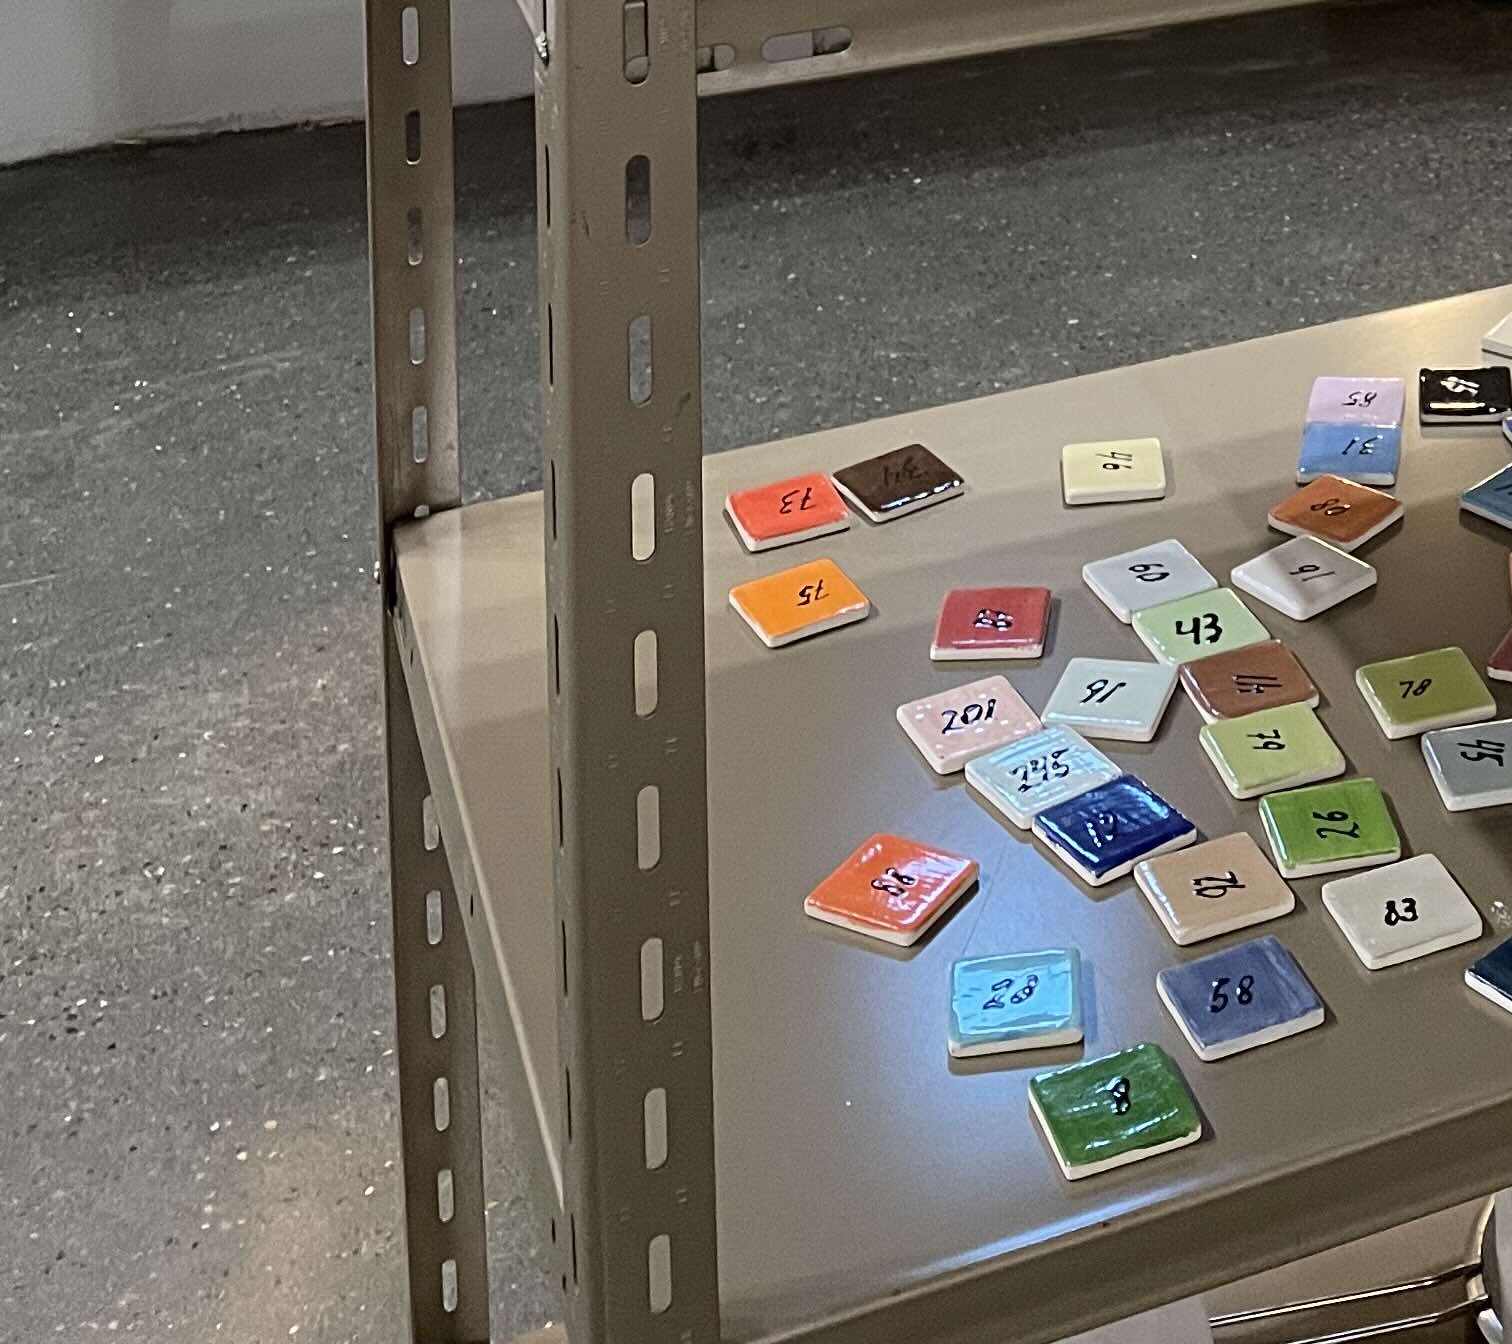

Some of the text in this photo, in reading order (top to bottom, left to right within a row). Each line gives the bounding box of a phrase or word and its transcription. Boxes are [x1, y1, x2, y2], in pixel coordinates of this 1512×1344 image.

[1175, 613, 1223, 645] 43
[1400, 678, 1433, 699] 78
[941, 698, 997, 735] 201
[1384, 897, 1419, 927] 83
[1209, 974, 1255, 1013] 58
